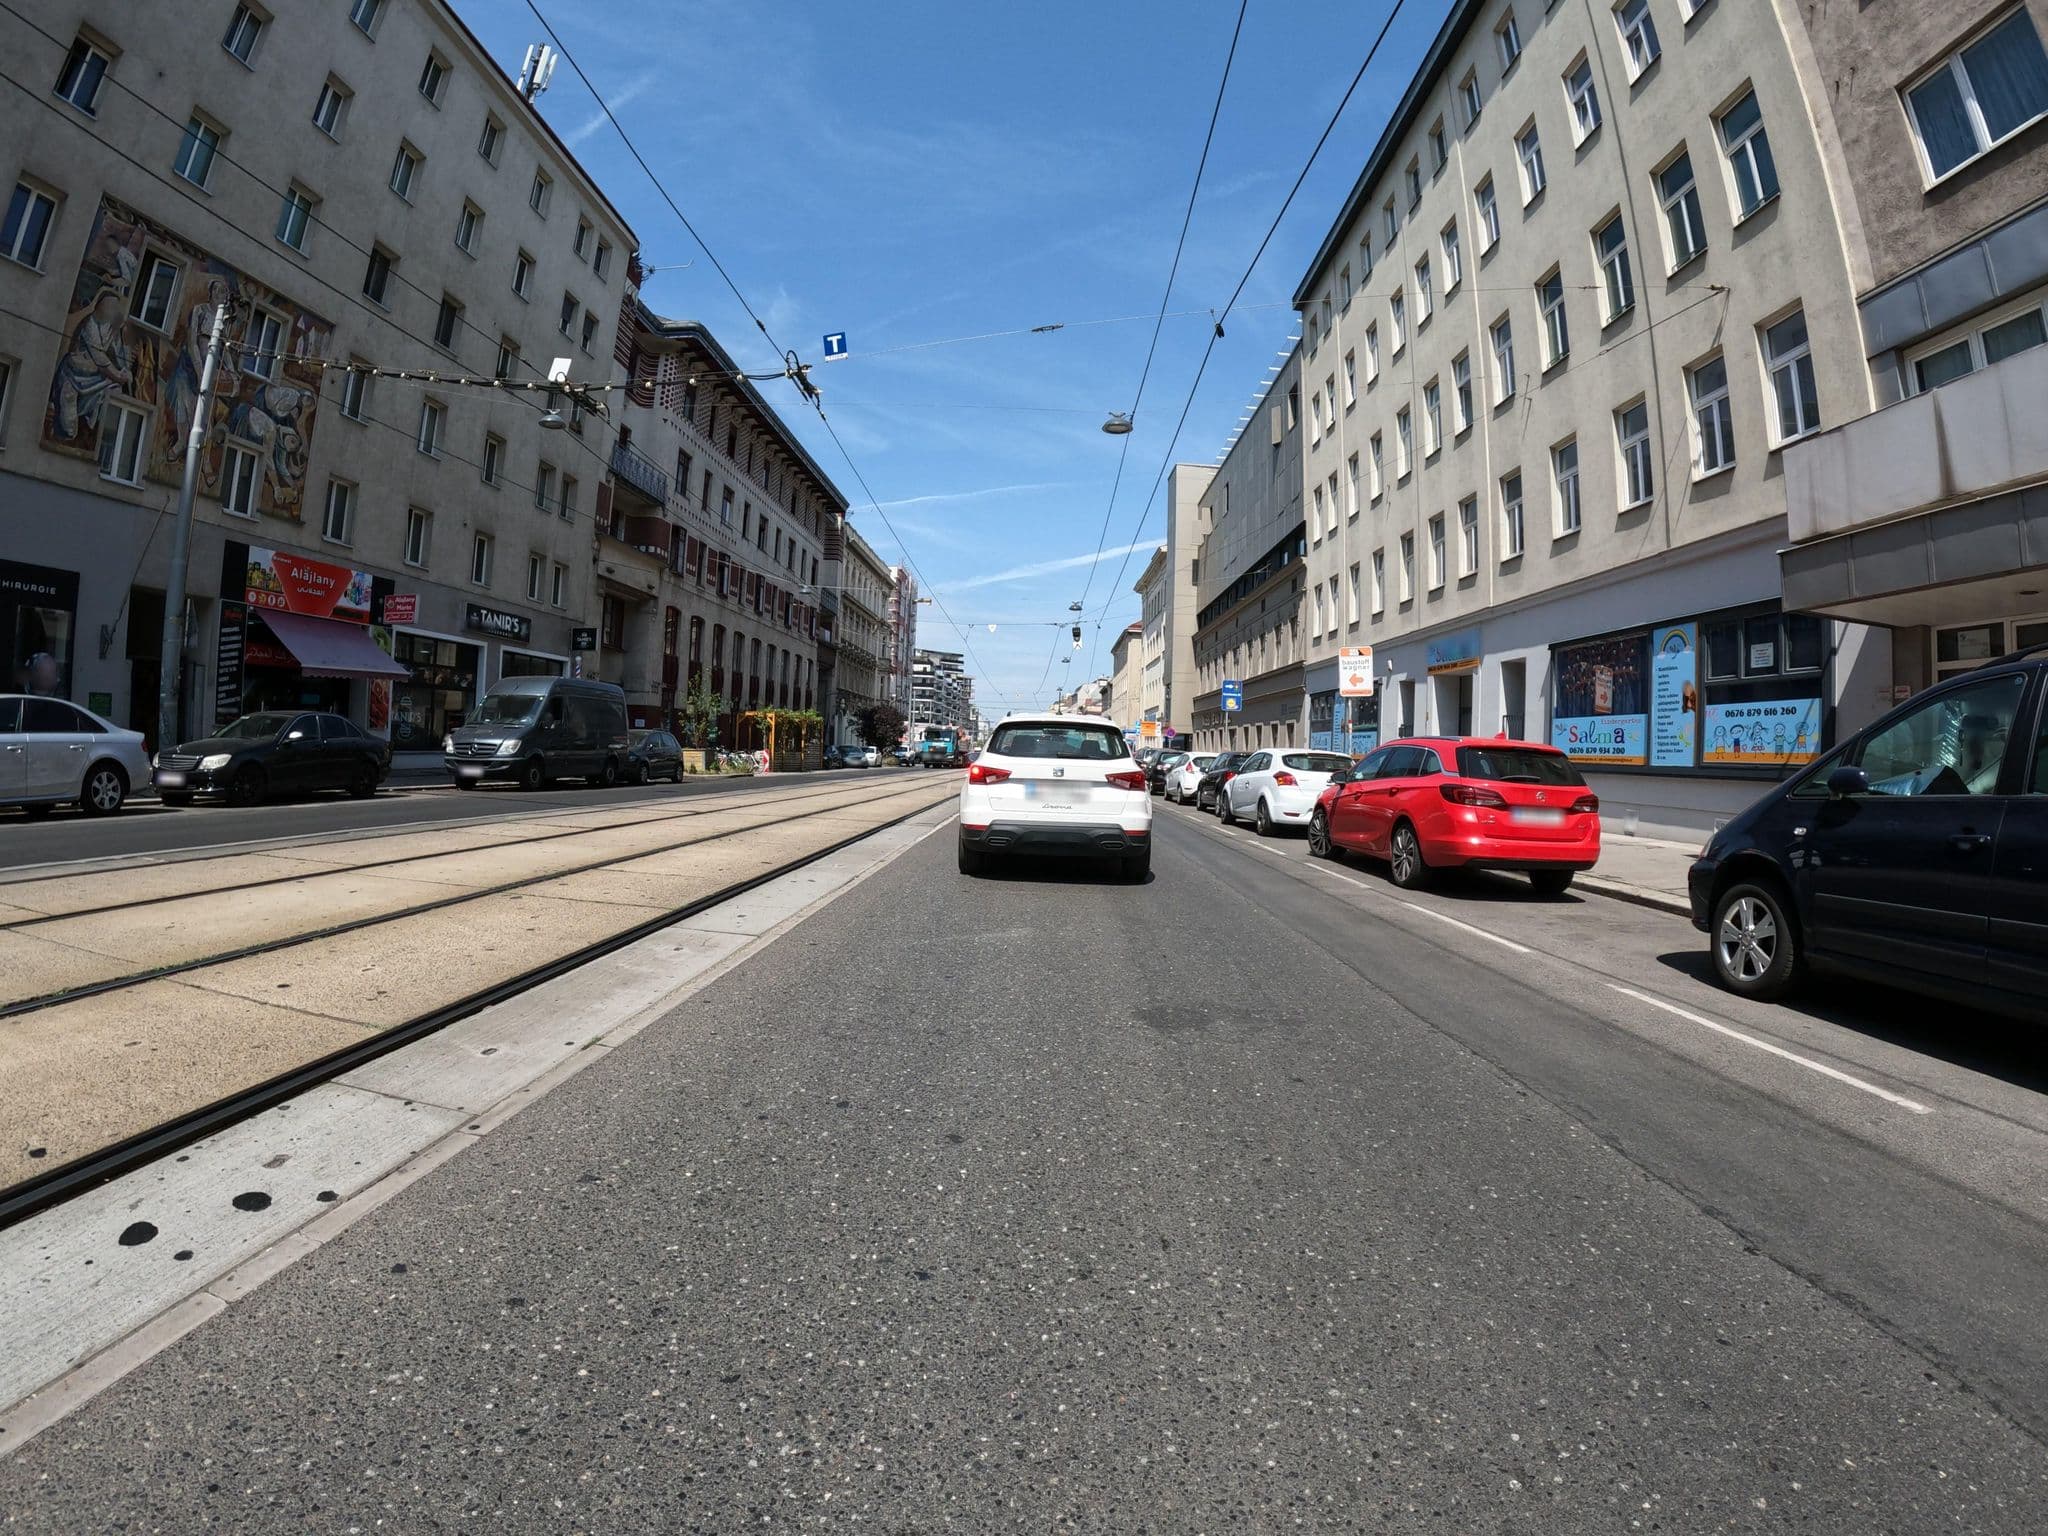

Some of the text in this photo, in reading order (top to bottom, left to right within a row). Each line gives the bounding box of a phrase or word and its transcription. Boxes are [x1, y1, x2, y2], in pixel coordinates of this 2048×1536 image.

[827, 334, 842, 353] T
[0, 579, 57, 595] HIRURGIE
[480, 610, 519, 632] TANIR'S
[1725, 709, 1744, 718] 0676
[1747, 708, 1761, 717] 879
[1763, 708, 1778, 716] 616
[1781, 706, 1797, 715] 260
[1568, 720, 1626, 745] Salma
